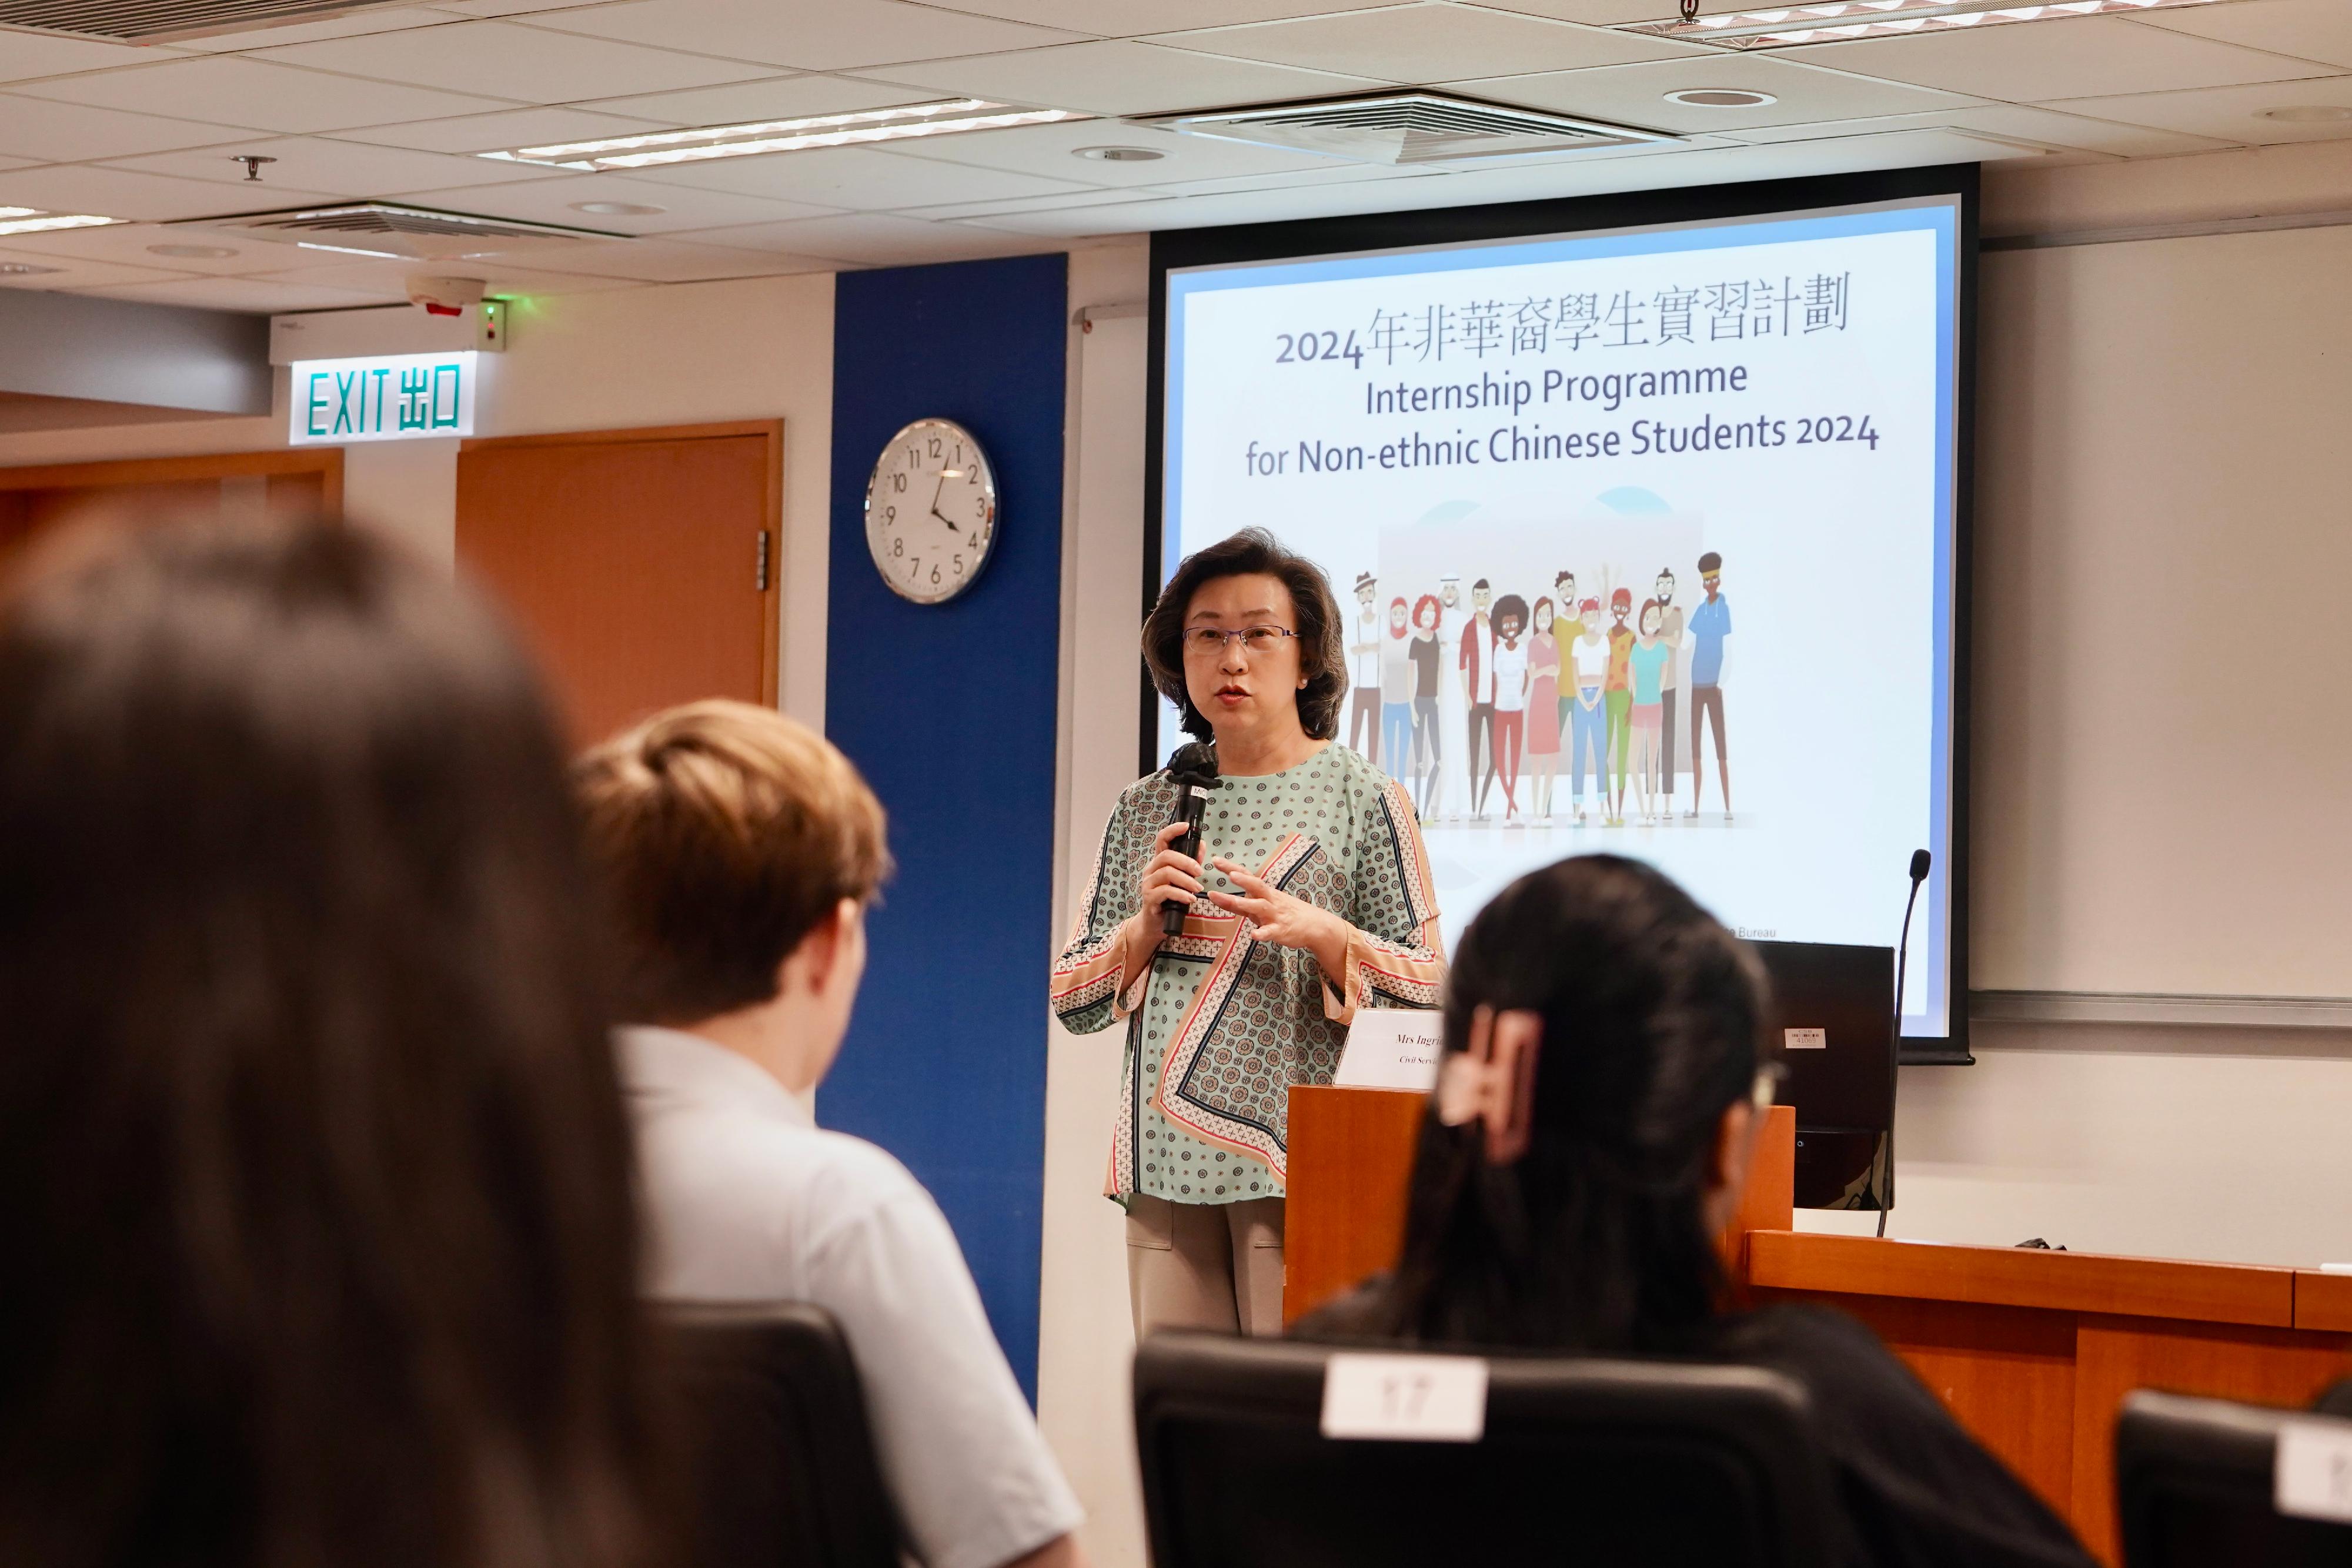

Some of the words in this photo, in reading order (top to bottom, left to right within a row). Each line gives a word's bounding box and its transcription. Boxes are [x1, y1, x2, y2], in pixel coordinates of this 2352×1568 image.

[1275, 271, 1850, 369] 2024年非華裔學生實習計劃
[308, 368, 390, 436] EXIT
[399, 364, 460, 432] 出口
[1367, 369, 1532, 416] Internship
[1544, 365, 1748, 411] Programme
[928, 438, 942, 459] 12
[956, 444, 961, 464] 1
[1246, 441, 1289, 476] for
[1299, 429, 1480, 473] Non-ethnic
[1489, 423, 1621, 463] Chinese
[1631, 413, 1786, 455] Students
[1796, 415, 1880, 450] 2024
[908, 450, 920, 469] 11
[893, 473, 907, 493] 10
[968, 464, 978, 484] 2
[886, 506, 896, 526] 9
[976, 497, 985, 517] 3
[893, 538, 904, 557] 8
[968, 531, 978, 549] 4
[911, 557, 920, 577] 7
[930, 564, 941, 584] 6
[953, 554, 963, 574] 5
[1194, 788, 1206, 797] MIC
[1739, 927, 1776, 938] Bureau
[1395, 1034, 1414, 1044] Mrs
[1399, 1055, 1416, 1064] Civil
